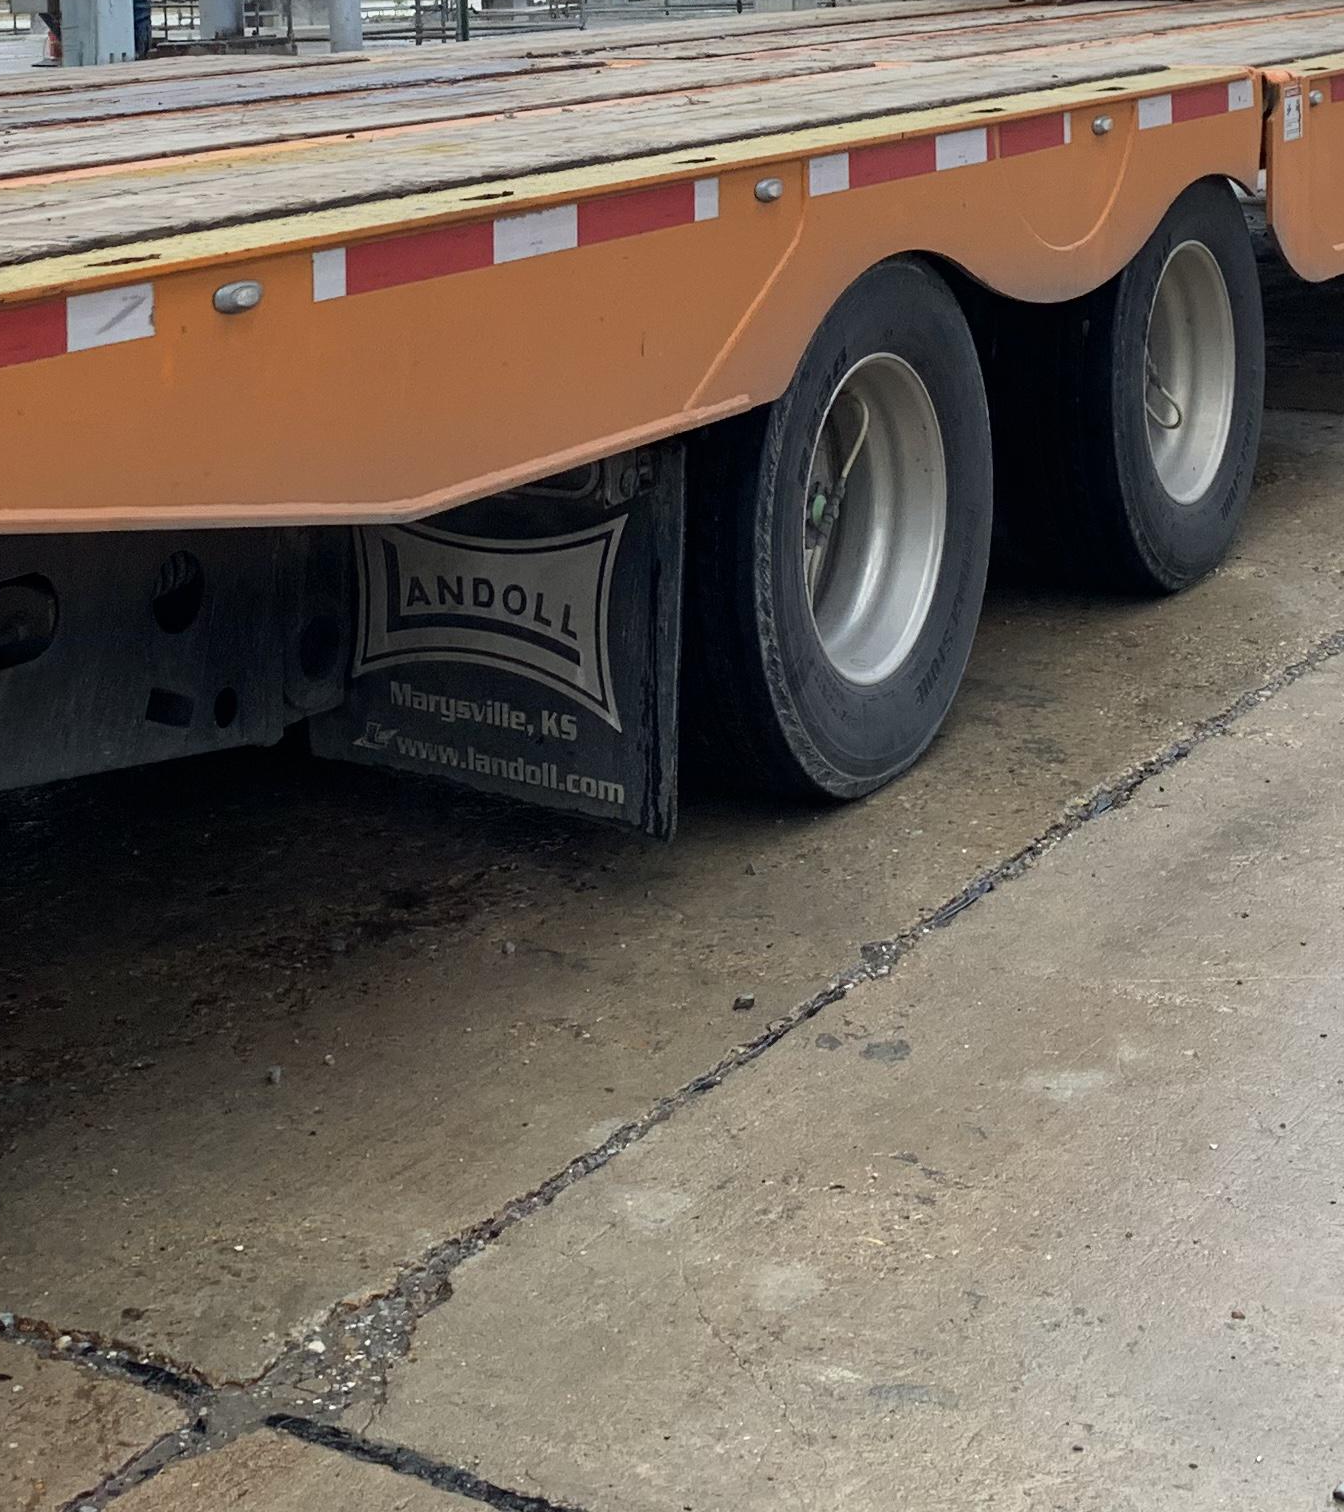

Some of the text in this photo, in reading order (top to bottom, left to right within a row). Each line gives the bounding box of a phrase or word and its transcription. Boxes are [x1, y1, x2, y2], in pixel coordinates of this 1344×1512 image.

[390, 681, 578, 741] Marysville, KS
[399, 736, 626, 805] www.landoll.com
